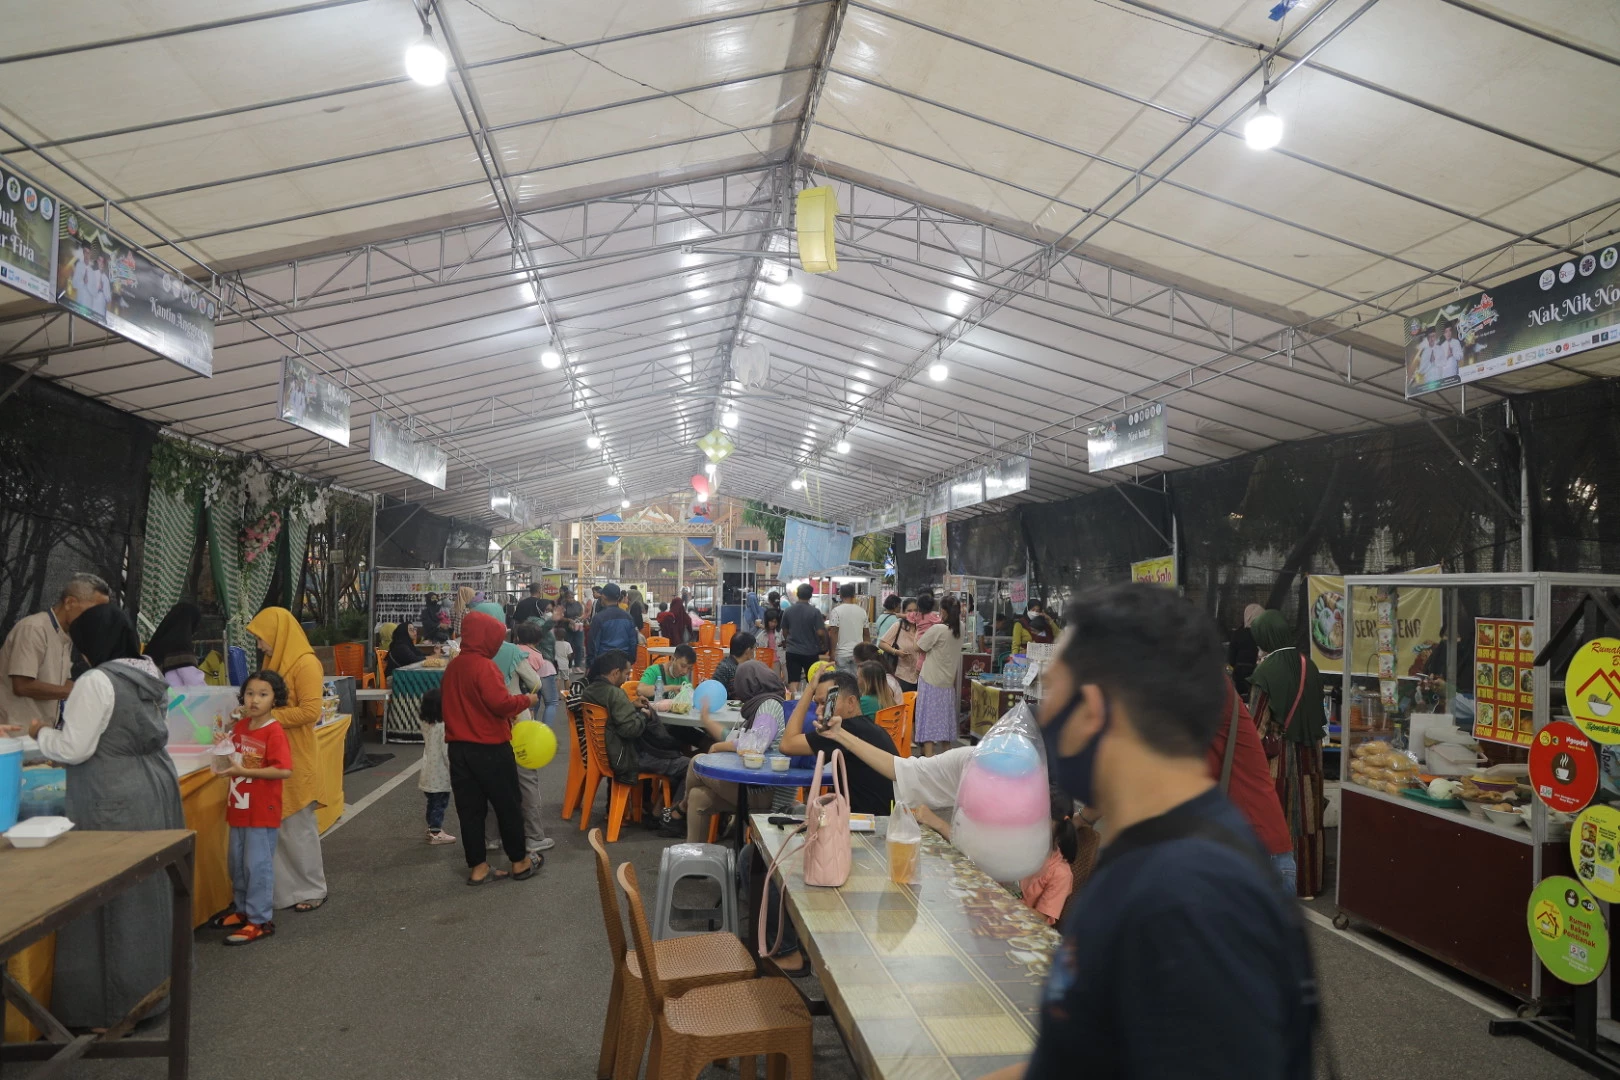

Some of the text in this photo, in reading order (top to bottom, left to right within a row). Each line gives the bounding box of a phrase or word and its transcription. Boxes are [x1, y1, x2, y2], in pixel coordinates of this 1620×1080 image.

[10, 233, 35, 262] Fira
[150, 296, 176, 324] Kantin
[1528, 304, 1563, 328] Nak
[1562, 293, 1596, 317] Nik
[1156, 568, 1172, 582] Solo
[1569, 915, 1591, 930] Rumah
[1570, 924, 1590, 938] Bakso
[1563, 929, 1596, 949] Pontianak
